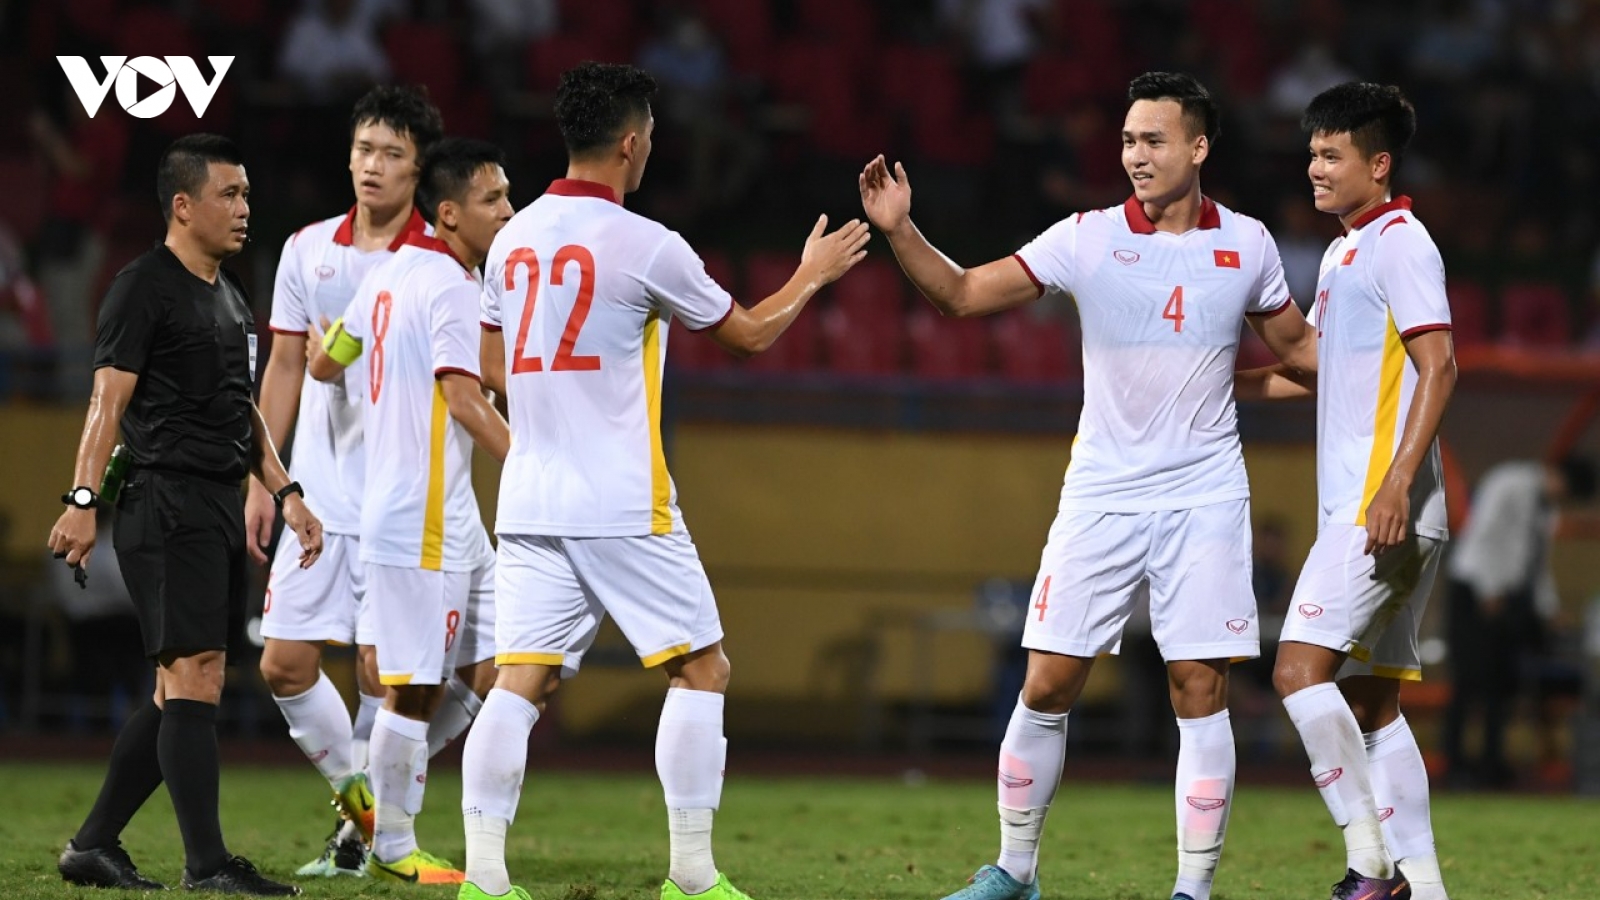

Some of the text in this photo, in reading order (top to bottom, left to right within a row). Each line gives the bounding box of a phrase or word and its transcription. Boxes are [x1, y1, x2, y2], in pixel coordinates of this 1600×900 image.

[504, 244, 601, 375] 22
[1163, 285, 1185, 333] 4
[369, 290, 392, 406] 8
[1035, 575, 1051, 622] 4
[445, 610, 460, 654] 8
